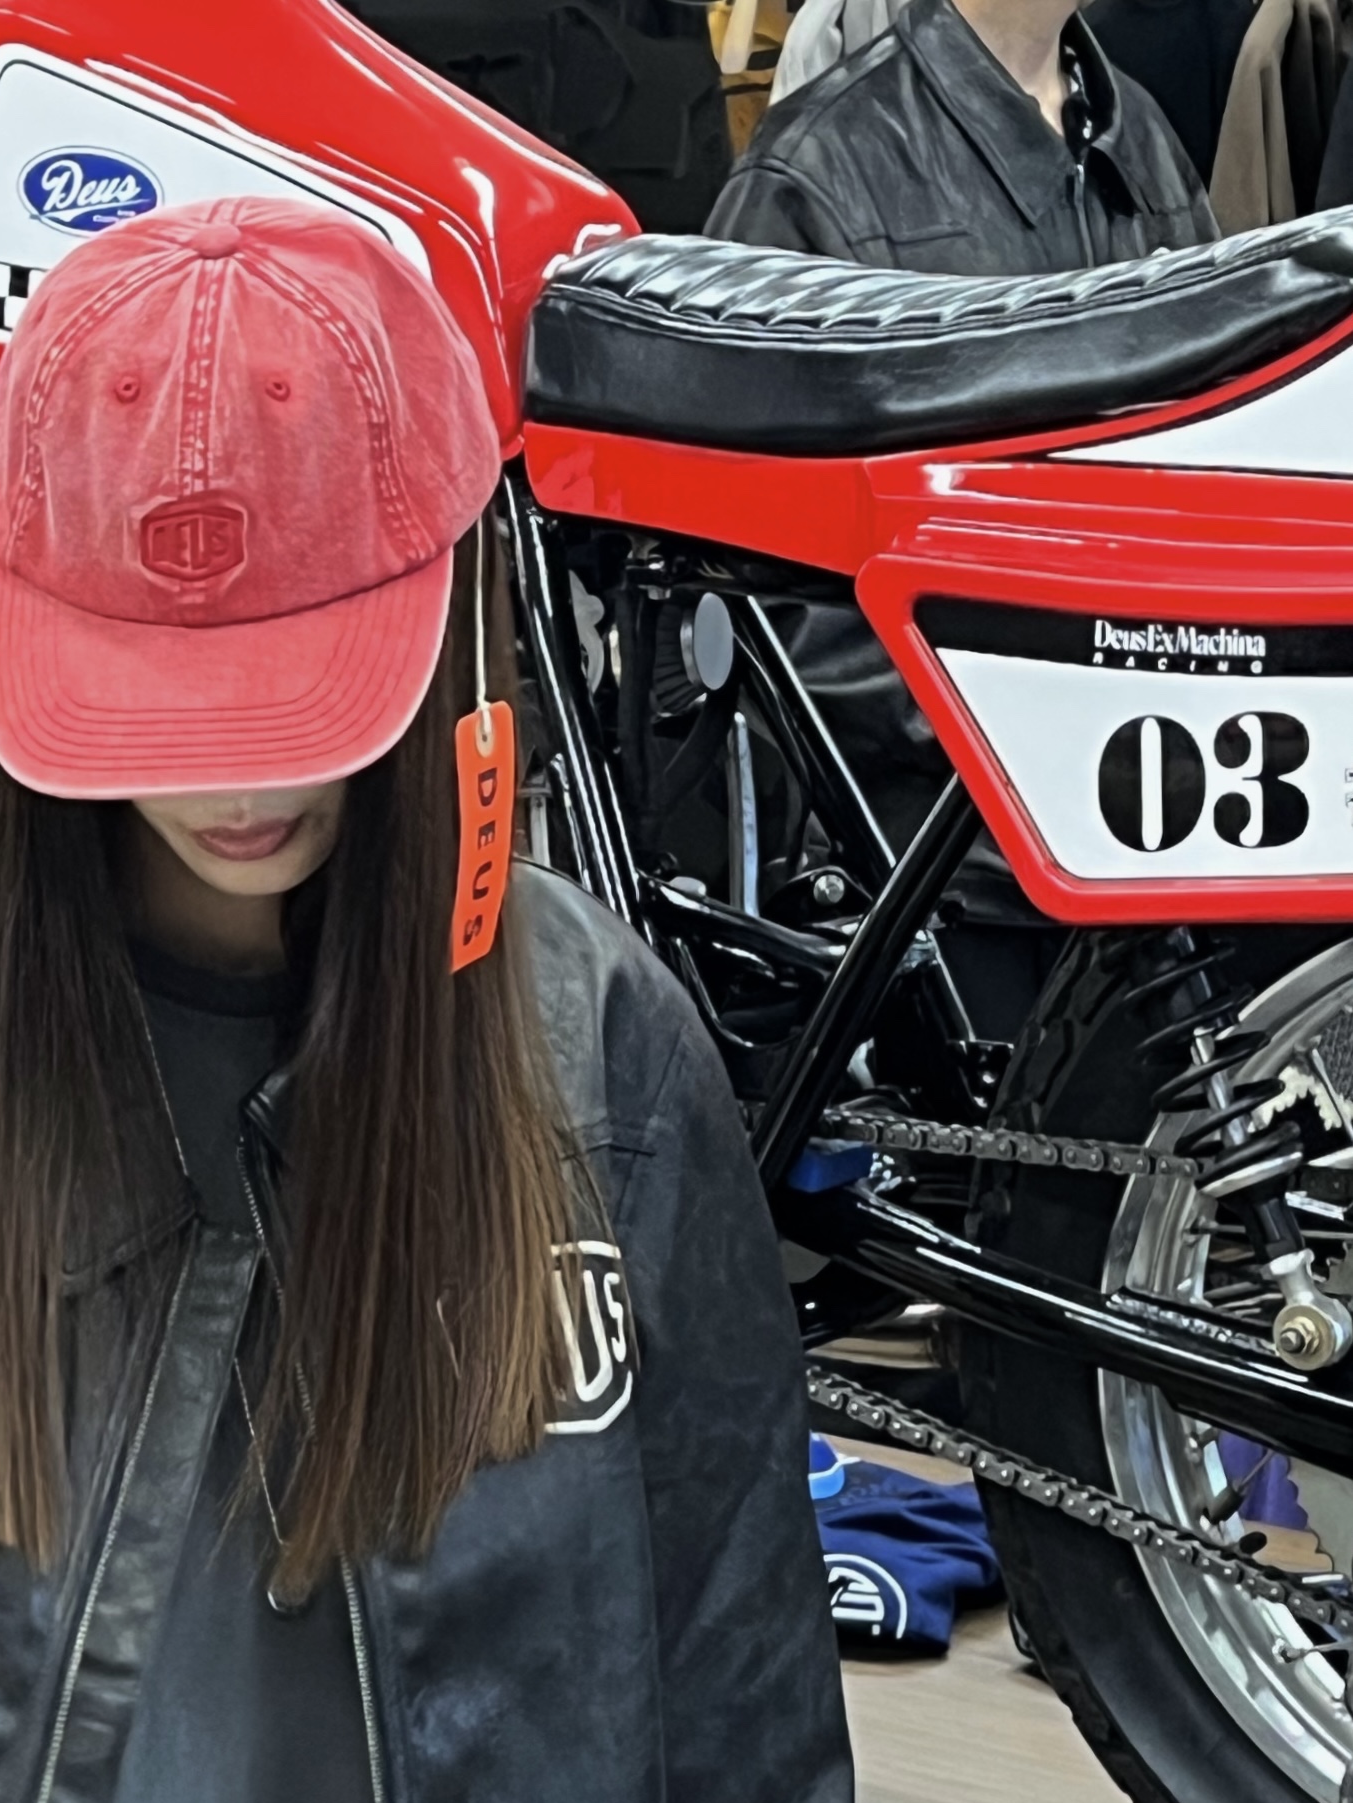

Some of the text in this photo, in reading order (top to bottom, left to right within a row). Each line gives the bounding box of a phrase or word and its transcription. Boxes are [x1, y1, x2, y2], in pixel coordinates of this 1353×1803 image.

[41, 159, 141, 212] Deus
[1098, 711, 1310, 853] 03
[463, 767, 498, 947] DEUS
[551, 1270, 627, 1402] US
